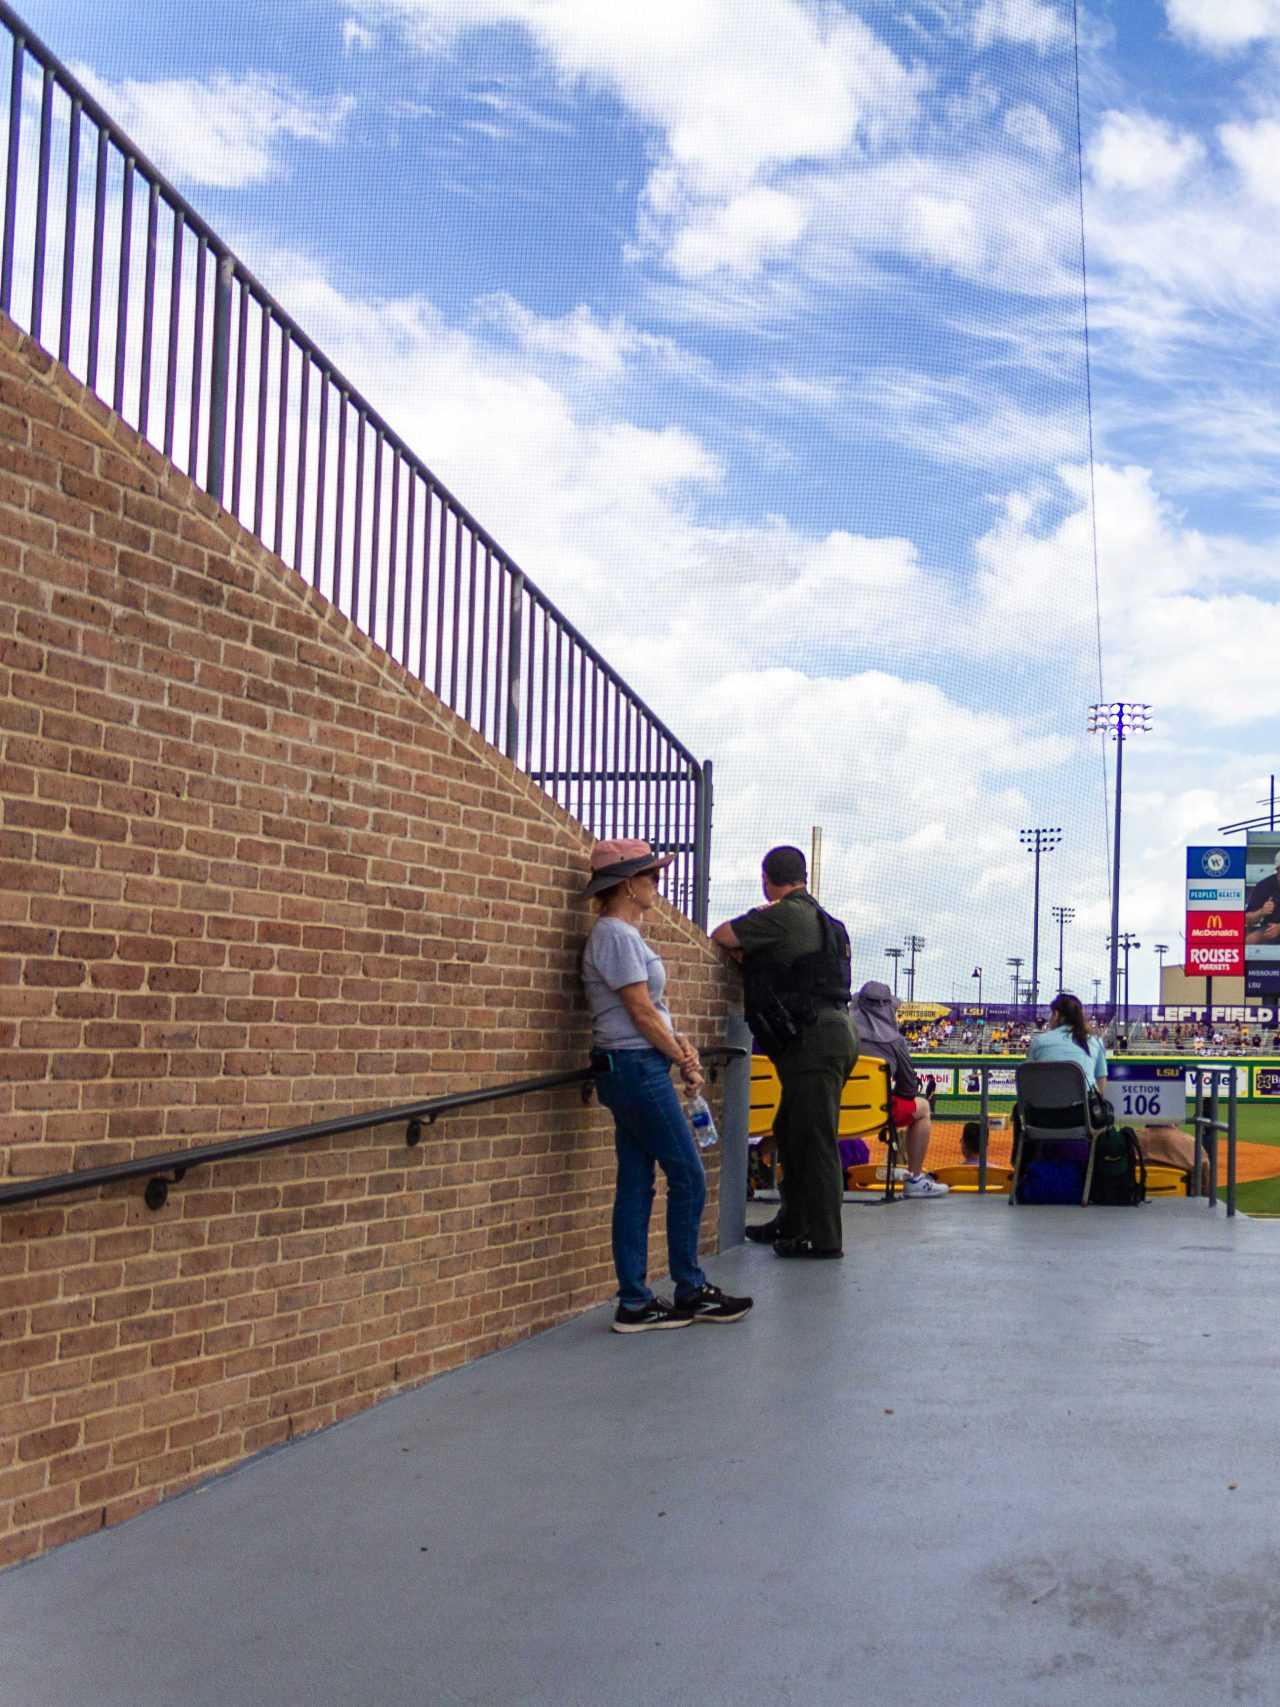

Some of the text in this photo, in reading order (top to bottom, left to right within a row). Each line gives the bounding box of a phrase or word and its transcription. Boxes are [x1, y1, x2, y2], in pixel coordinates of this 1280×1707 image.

[1192, 929, 1239, 937] McDonald's
[1190, 948, 1240, 963] ROUSES
[963, 1008, 984, 1016] LSU
[1151, 1007, 1207, 1022] LEFT
[1211, 1008, 1274, 1022] FIELD
[1156, 1068, 1179, 1077] LSU
[1122, 1085, 1160, 1094] SECTION
[1123, 1094, 1161, 1116] 106
